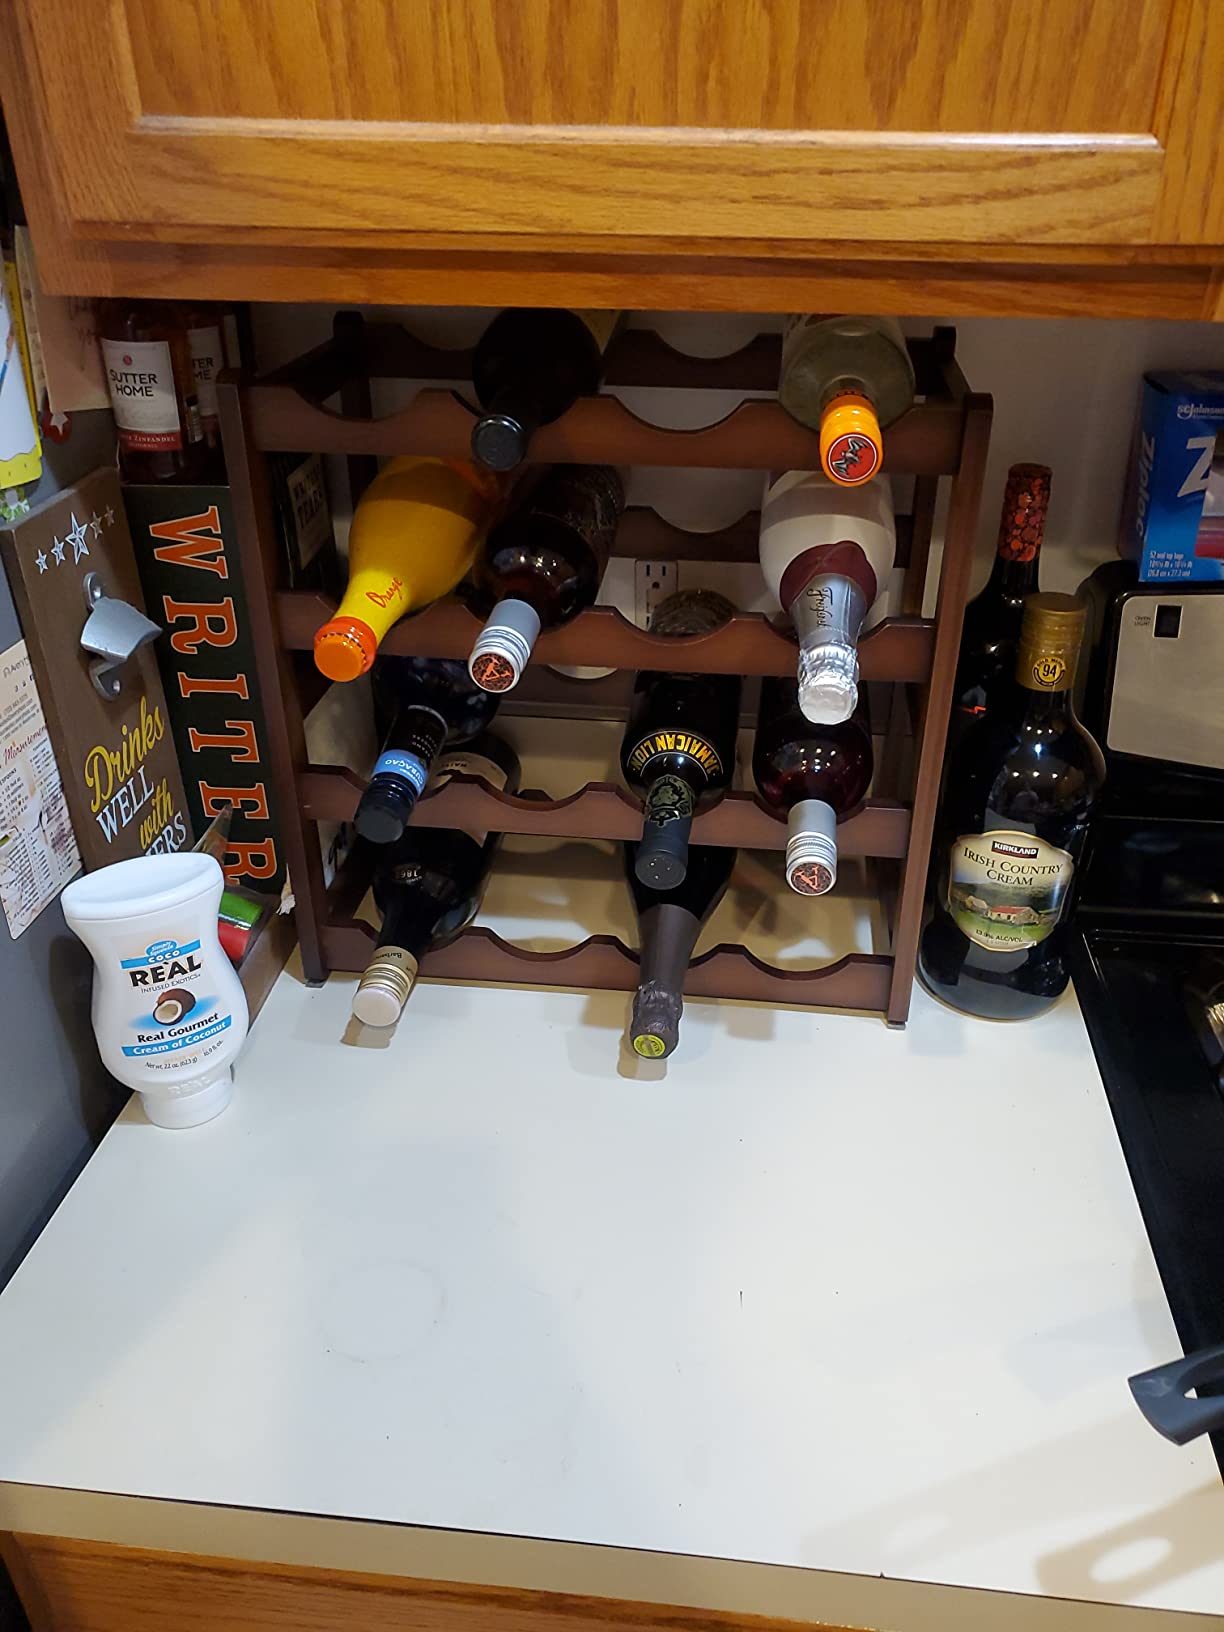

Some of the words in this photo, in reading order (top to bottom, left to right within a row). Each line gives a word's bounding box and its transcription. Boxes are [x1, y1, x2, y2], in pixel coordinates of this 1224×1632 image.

[110, 368, 159, 385] SUTTER
[116, 384, 154, 398] HOME
[1043, 663, 1057, 678] 94
[85, 696, 165, 813] Drinks
[629, 741, 656, 771] LION
[654, 733, 720, 775] JAMAICAN
[96, 765, 155, 844] WELL
[140, 778, 174, 850] with
[963, 847, 996, 868] IRISH
[993, 842, 1038, 855] KIRKLAND
[987, 869, 1034, 886] CREAM
[132, 1044, 169, 1055] Cream
[171, 1038, 183, 1049] of
[184, 1023, 227, 1046] Coconut
[137, 1031, 165, 1043] Real
[168, 1013, 219, 1038] Gourmet
